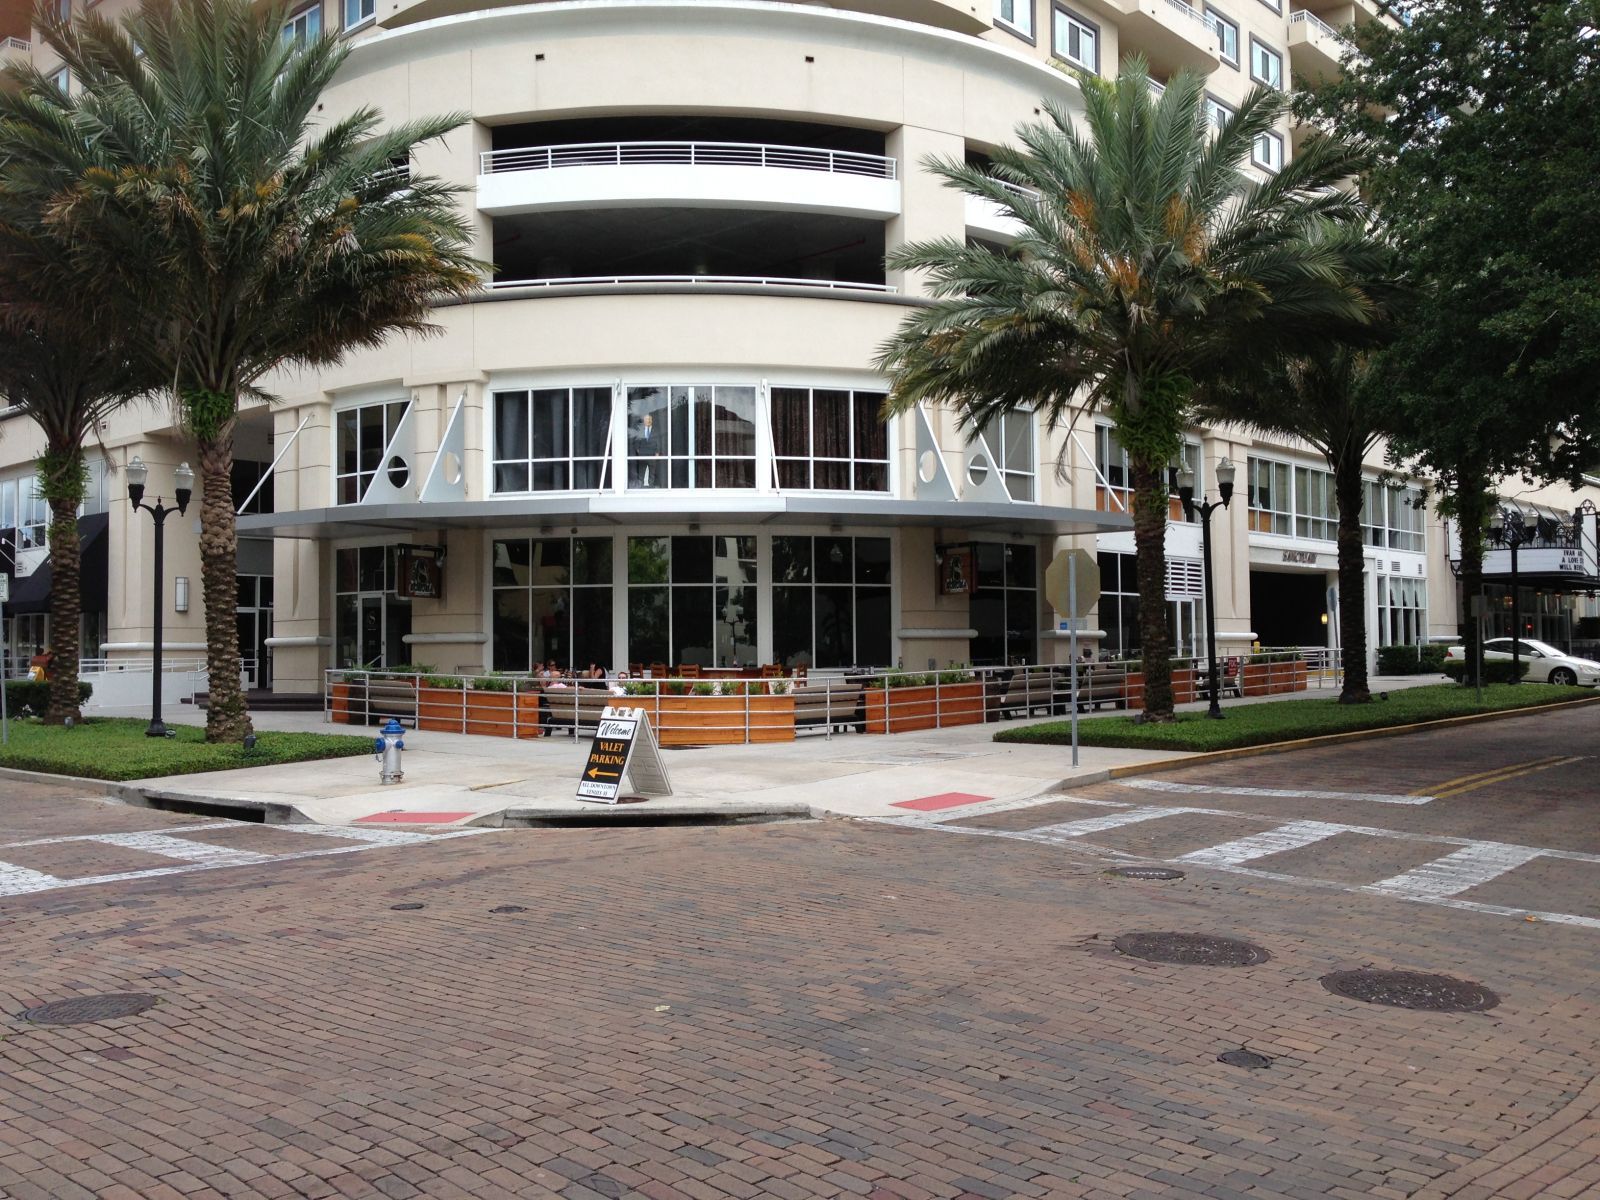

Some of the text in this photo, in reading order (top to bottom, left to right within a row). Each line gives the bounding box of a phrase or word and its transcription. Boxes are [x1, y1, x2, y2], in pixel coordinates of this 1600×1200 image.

[600, 722, 631, 736] Welcome
[600, 741, 625, 752] VALET
[590, 754, 625, 765] PARKING
